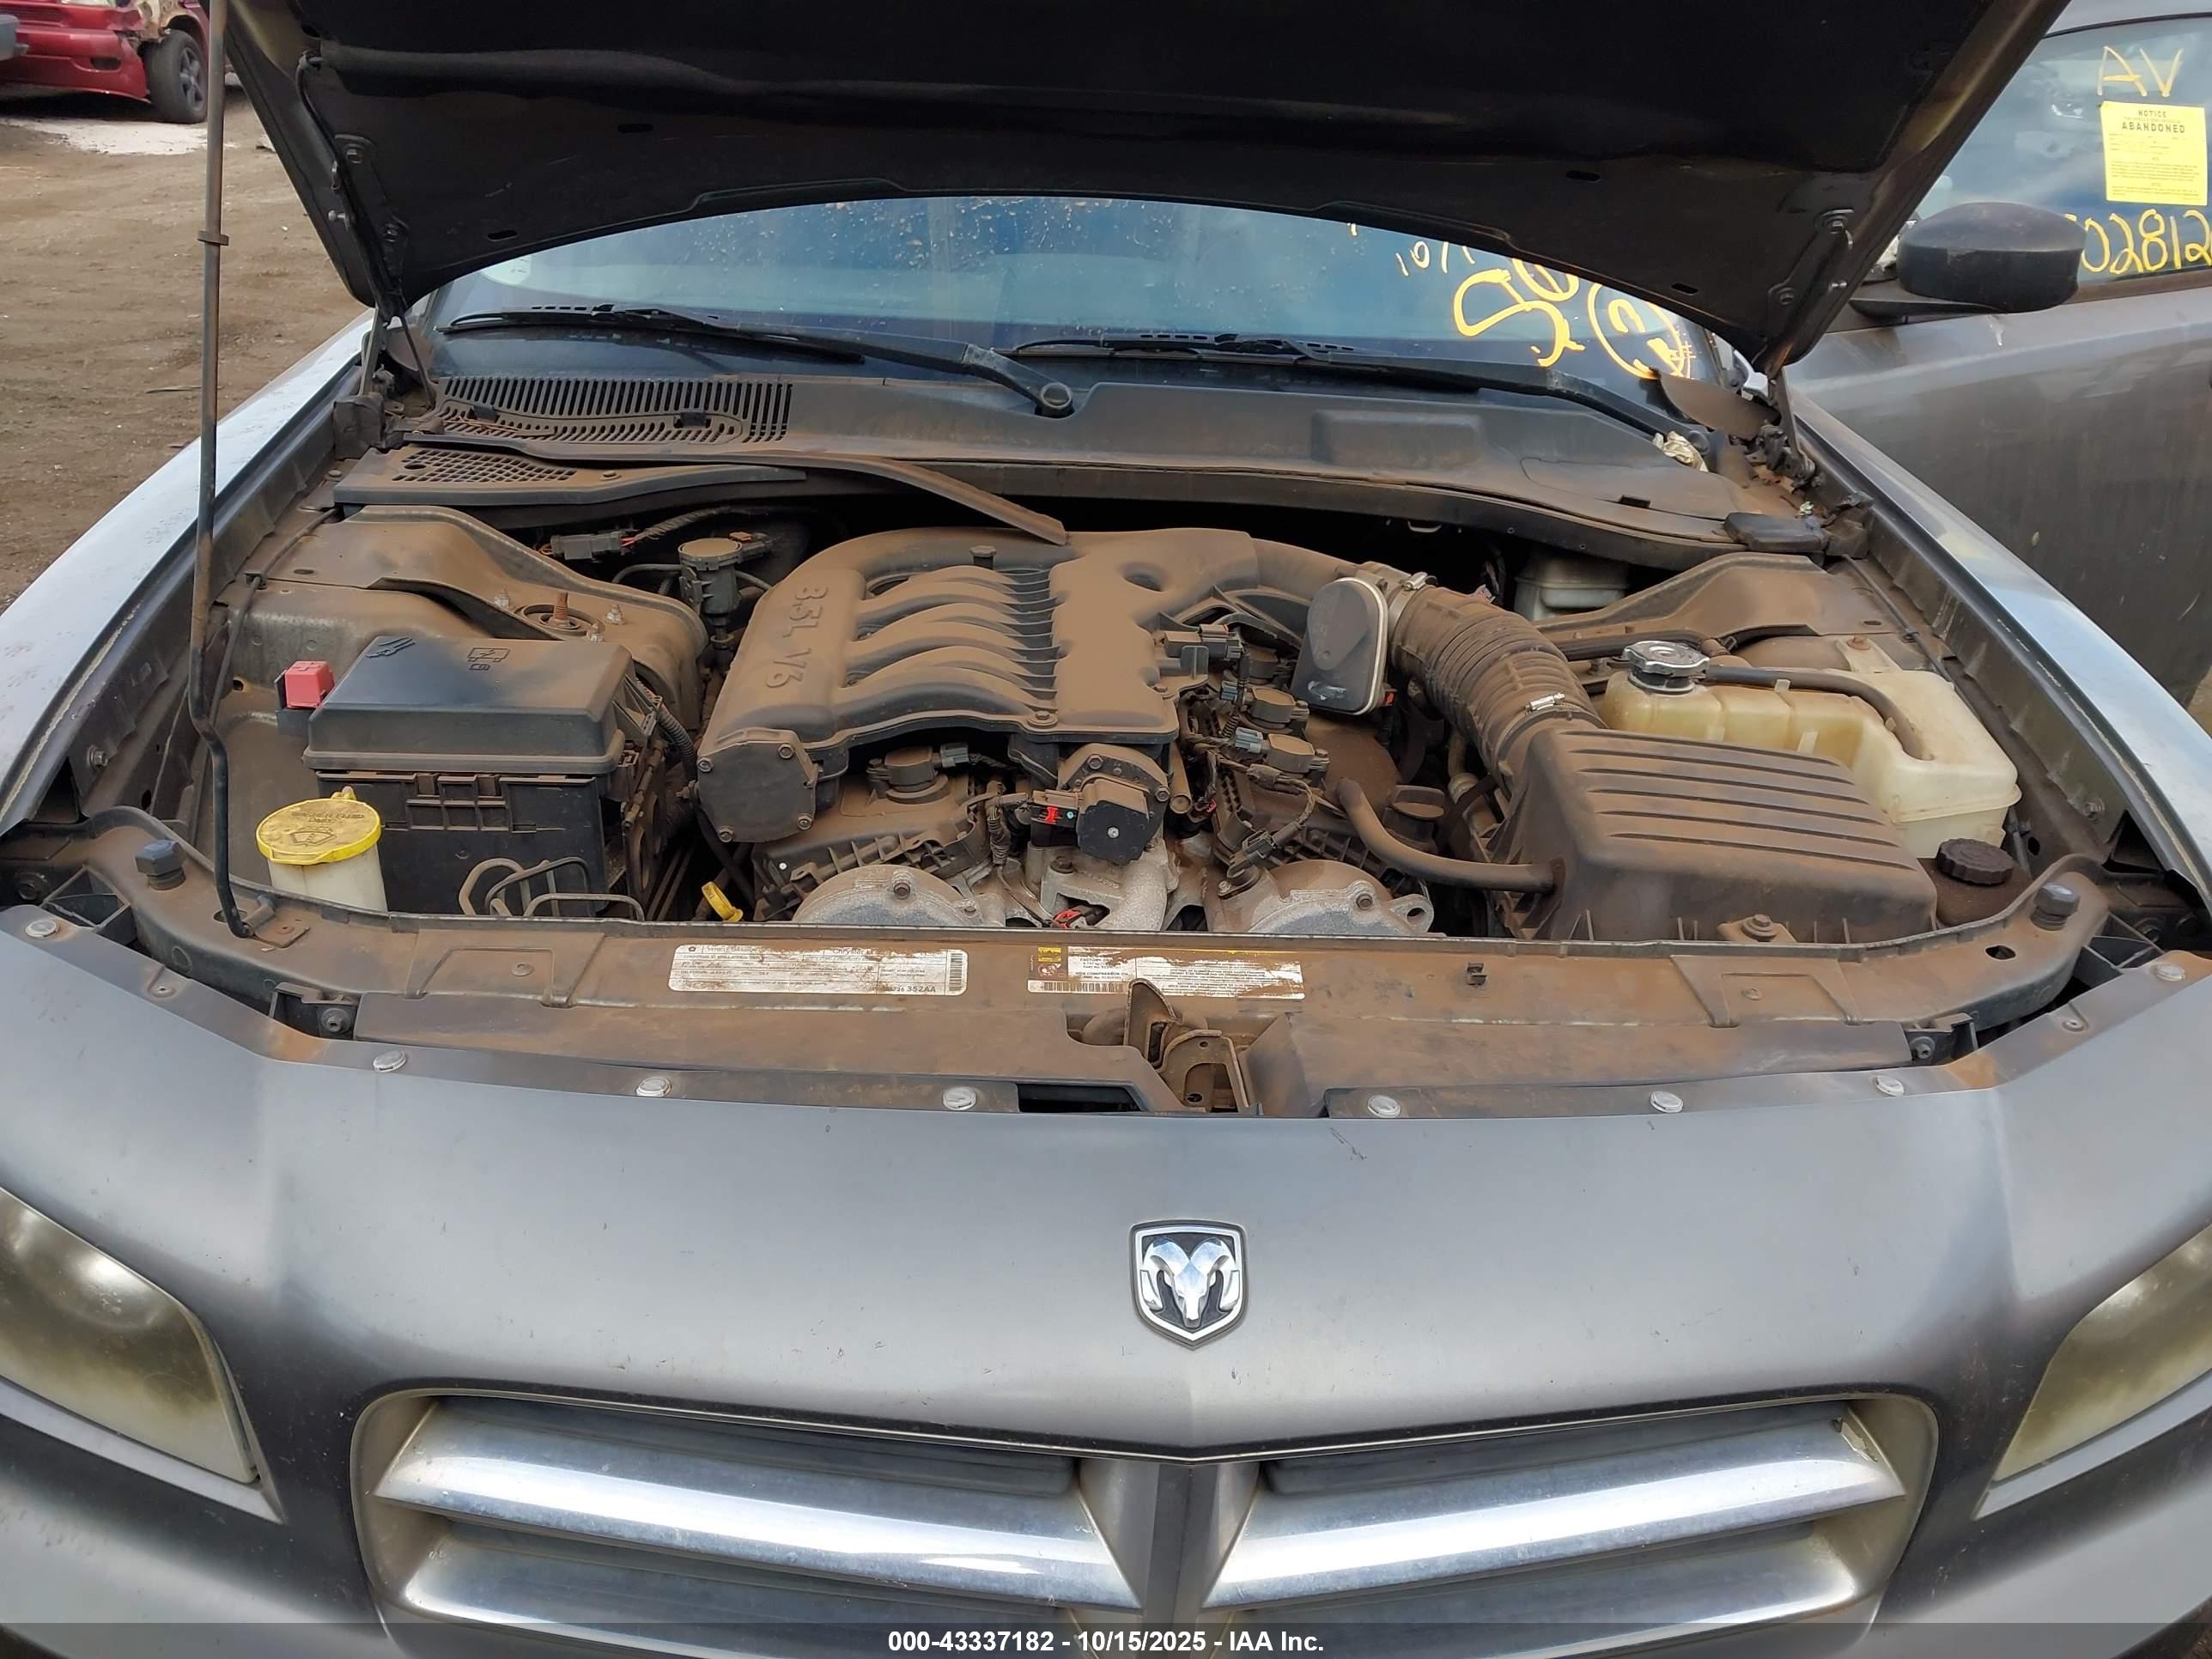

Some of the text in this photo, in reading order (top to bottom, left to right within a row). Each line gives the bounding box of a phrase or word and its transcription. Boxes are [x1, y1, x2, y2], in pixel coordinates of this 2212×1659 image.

[2096, 46, 2184, 97] AV
[2137, 109, 2168, 118] NOTICE
[2121, 121, 2186, 134] ABANDONED
[2063, 209, 2212, 275] 02812
[906, 985, 936, 994] 352AA
